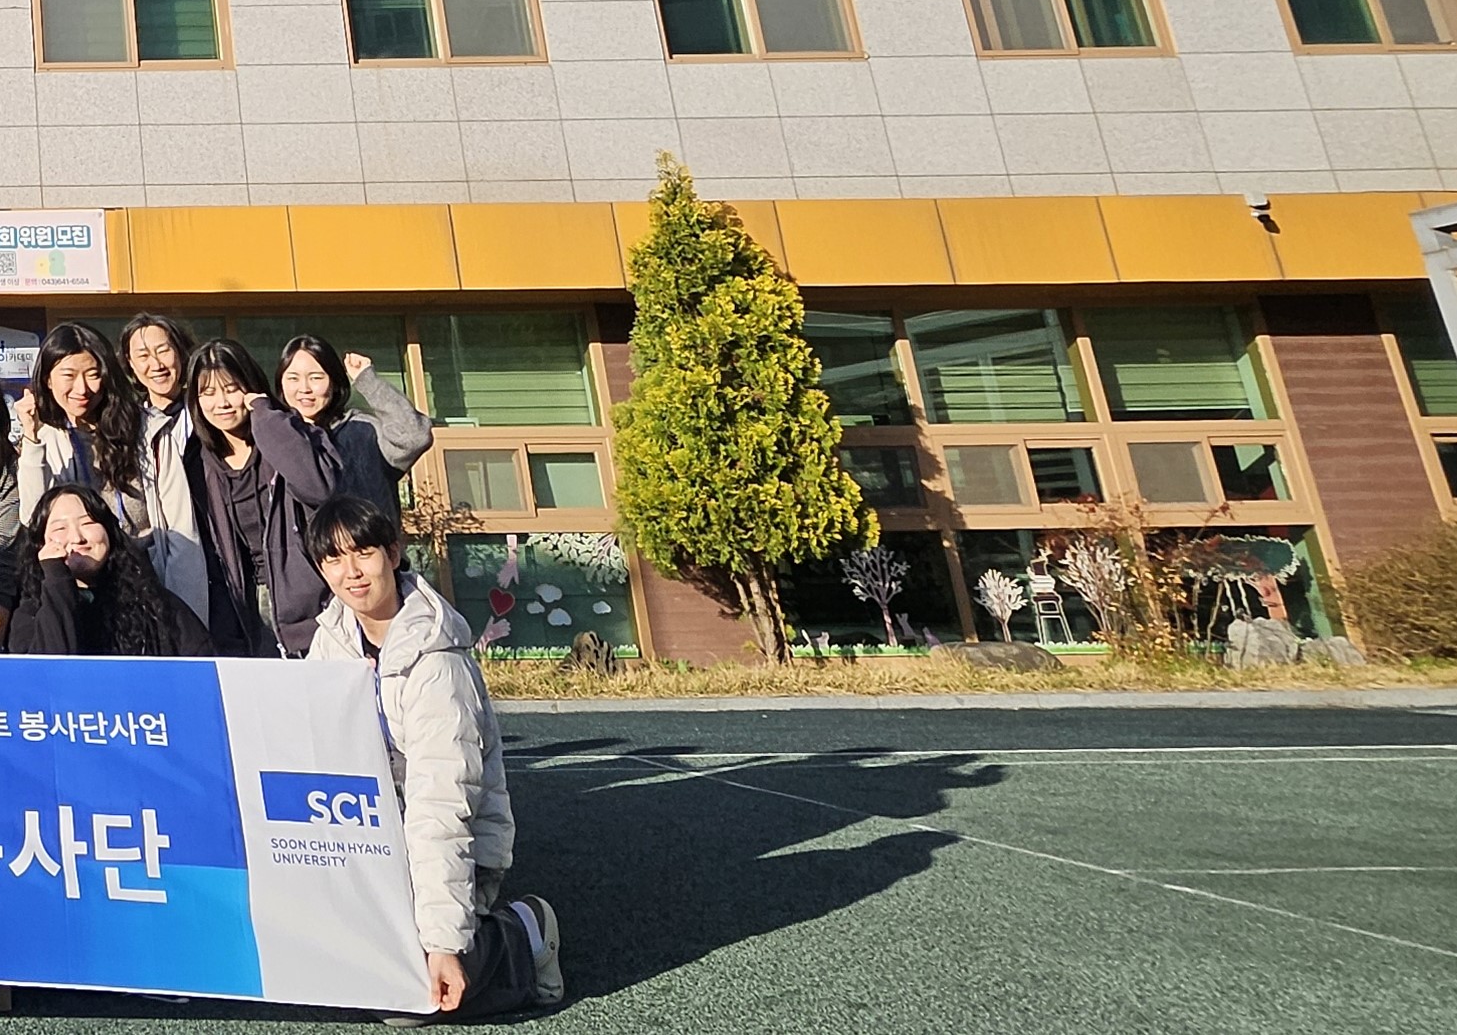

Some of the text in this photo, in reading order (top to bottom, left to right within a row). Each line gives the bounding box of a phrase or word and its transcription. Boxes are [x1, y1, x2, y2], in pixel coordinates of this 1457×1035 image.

[19, 226, 55, 248] 위원
[56, 225, 91, 248] 모집
[18, 709, 170, 747] 봉사단사업
[307, 790, 381, 828] SCH
[271, 838, 391, 856] SOON CHUN HYANG
[272, 852, 347, 867] UNIVERSITY
